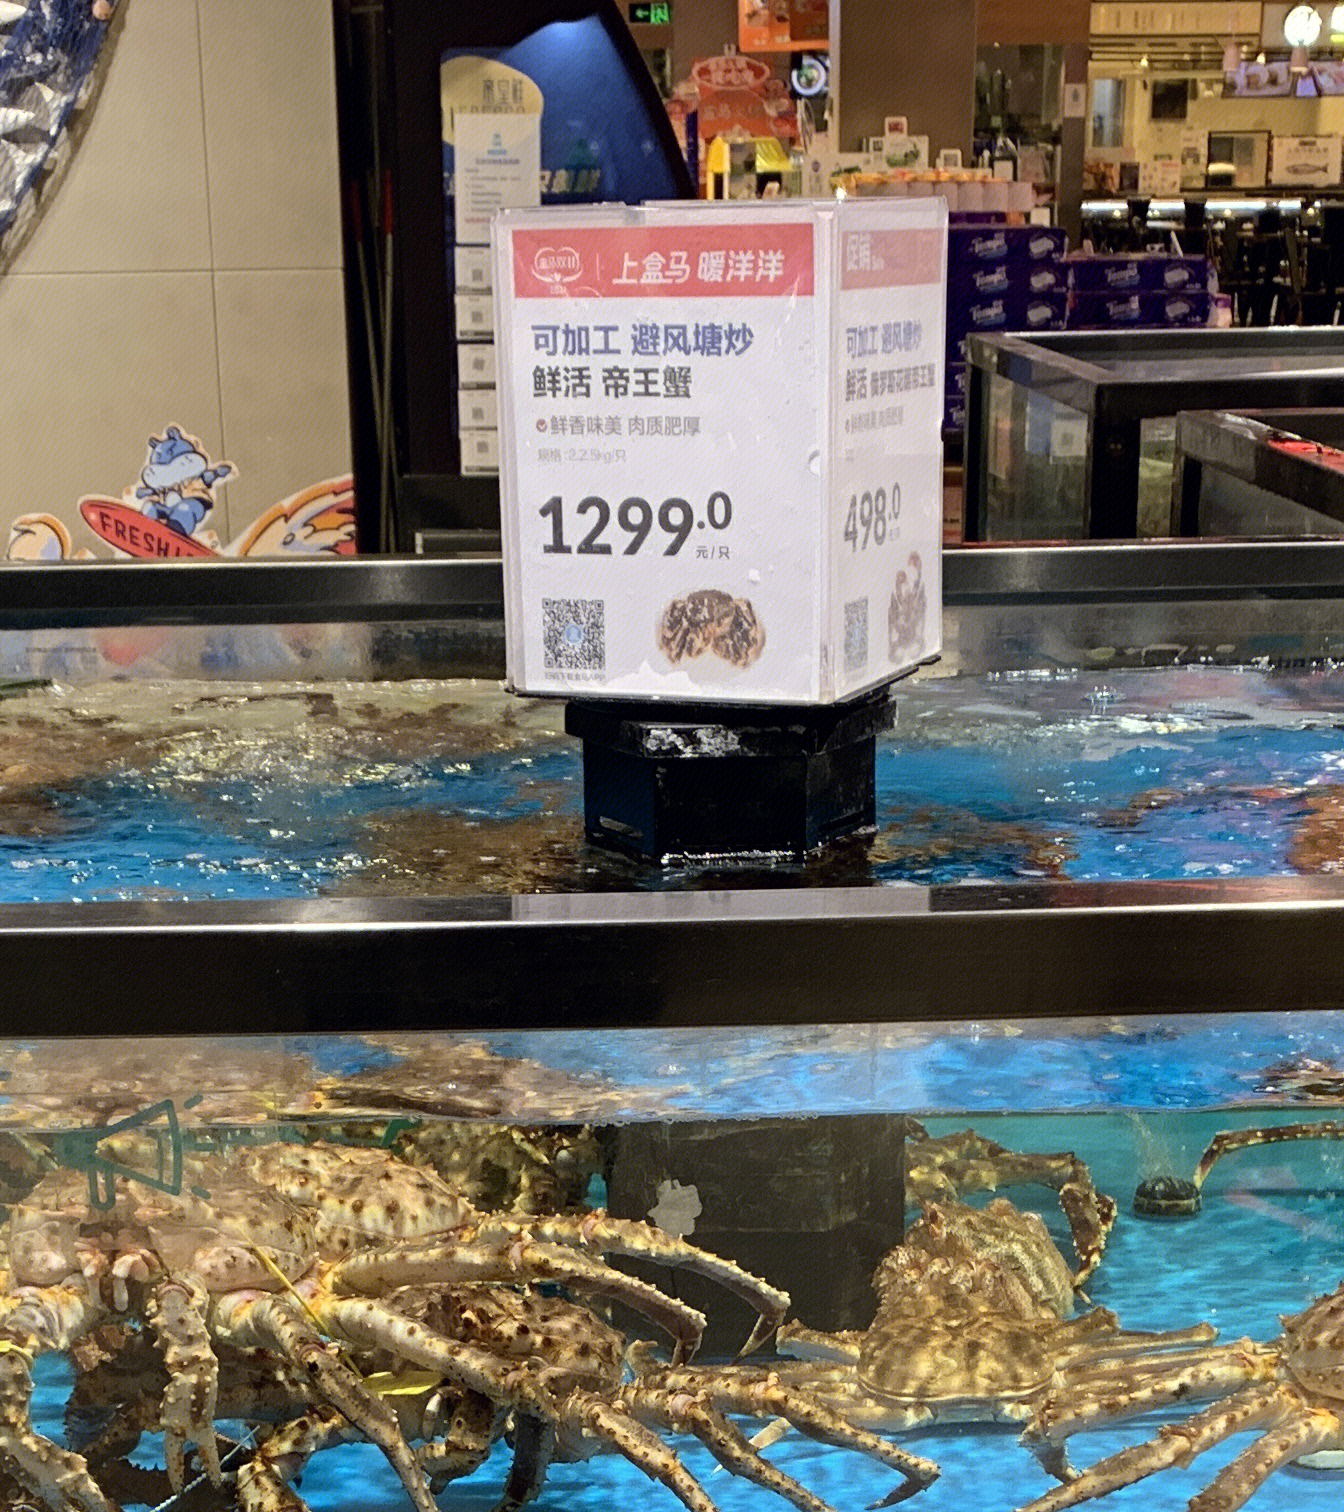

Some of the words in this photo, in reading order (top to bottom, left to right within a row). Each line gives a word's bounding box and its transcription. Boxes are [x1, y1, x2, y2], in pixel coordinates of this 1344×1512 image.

[612, 250, 692, 285] 上盒马
[698, 248, 786, 282] 暖洋洋
[531, 323, 622, 357] 可加工
[631, 323, 755, 357] 避风塘炒
[532, 365, 592, 400] 鲜活
[601, 364, 693, 399] 帝王蟹
[550, 415, 623, 436] 鲜香味美
[628, 415, 702, 436] 肉质肥厚
[538, 490, 733, 558] 1299.0
[844, 481, 902, 553] 498.0
